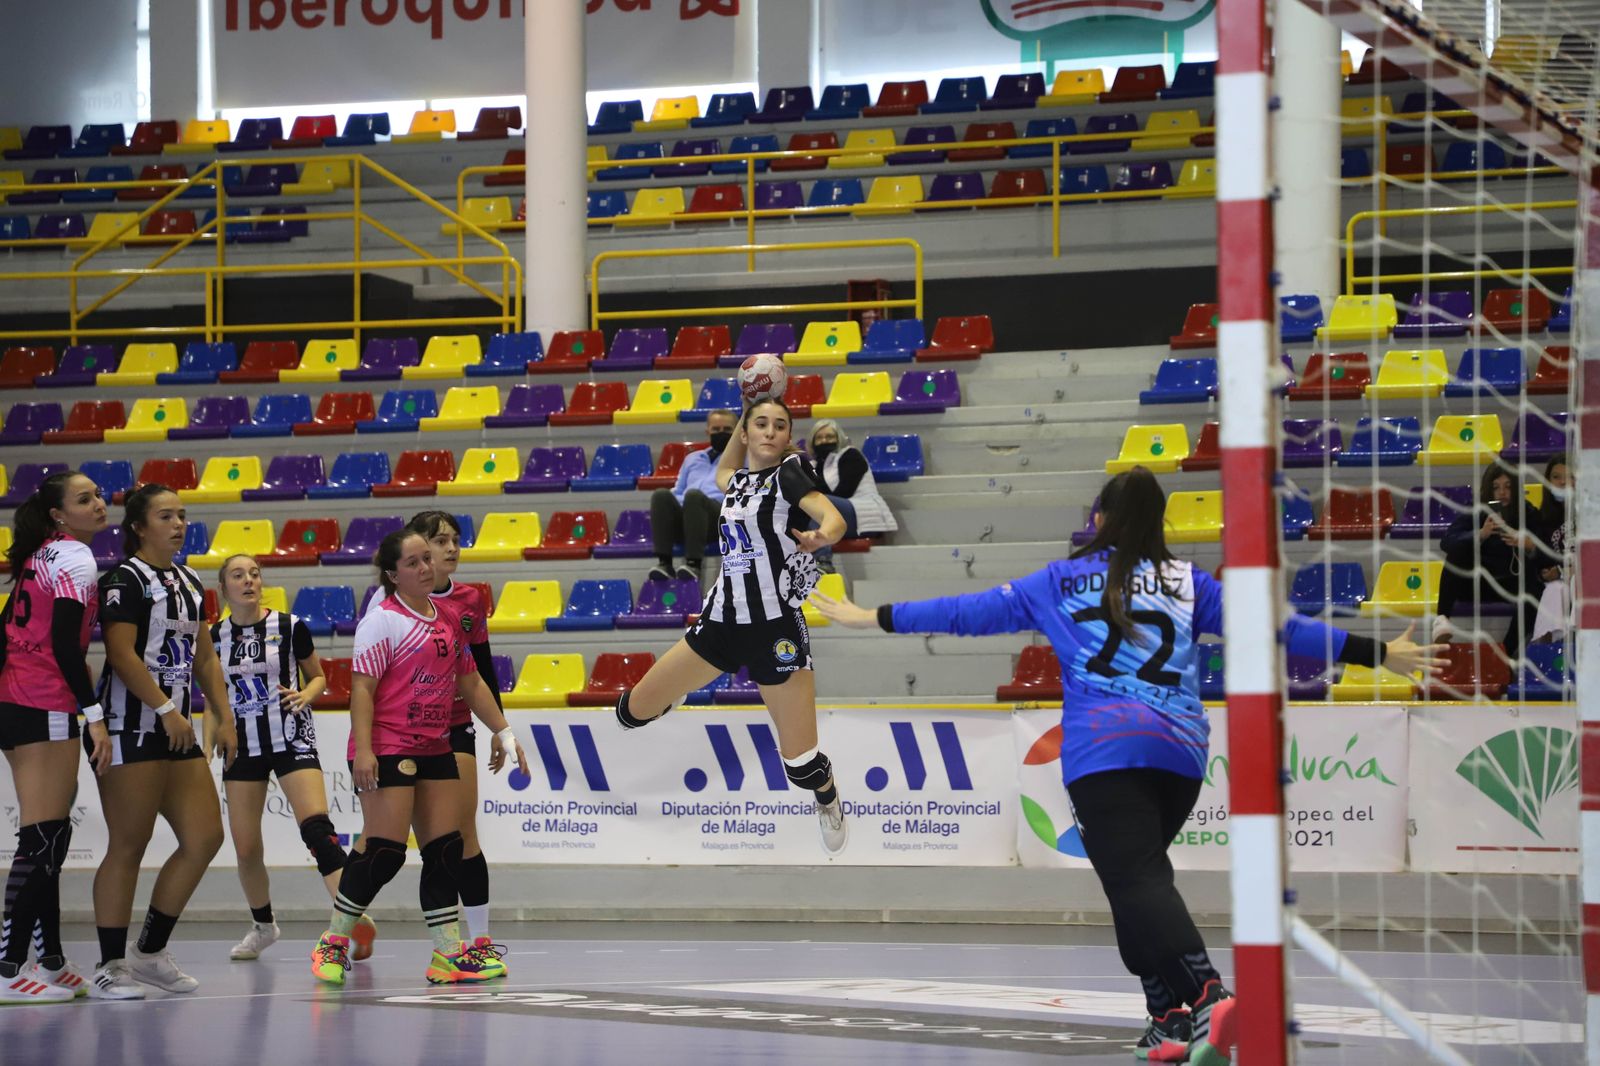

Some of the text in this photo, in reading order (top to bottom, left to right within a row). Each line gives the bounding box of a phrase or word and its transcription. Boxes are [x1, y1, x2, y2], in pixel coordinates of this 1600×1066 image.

[235, 640, 260, 660] 40
[433, 638, 449, 658] 13
[1071, 606, 1182, 687] 22
[484, 800, 638, 816] Diputación Provincial
[661, 801, 817, 818] Diputación Provincial
[842, 801, 1001, 818] Diputación Provincial
[1186, 805, 1229, 826] egió
[1342, 805, 1374, 821] del
[522, 819, 598, 835] de Málaga
[701, 819, 776, 836] de Málaga
[882, 819, 960, 836] de Málaga
[1172, 830, 1229, 846] DEPO
